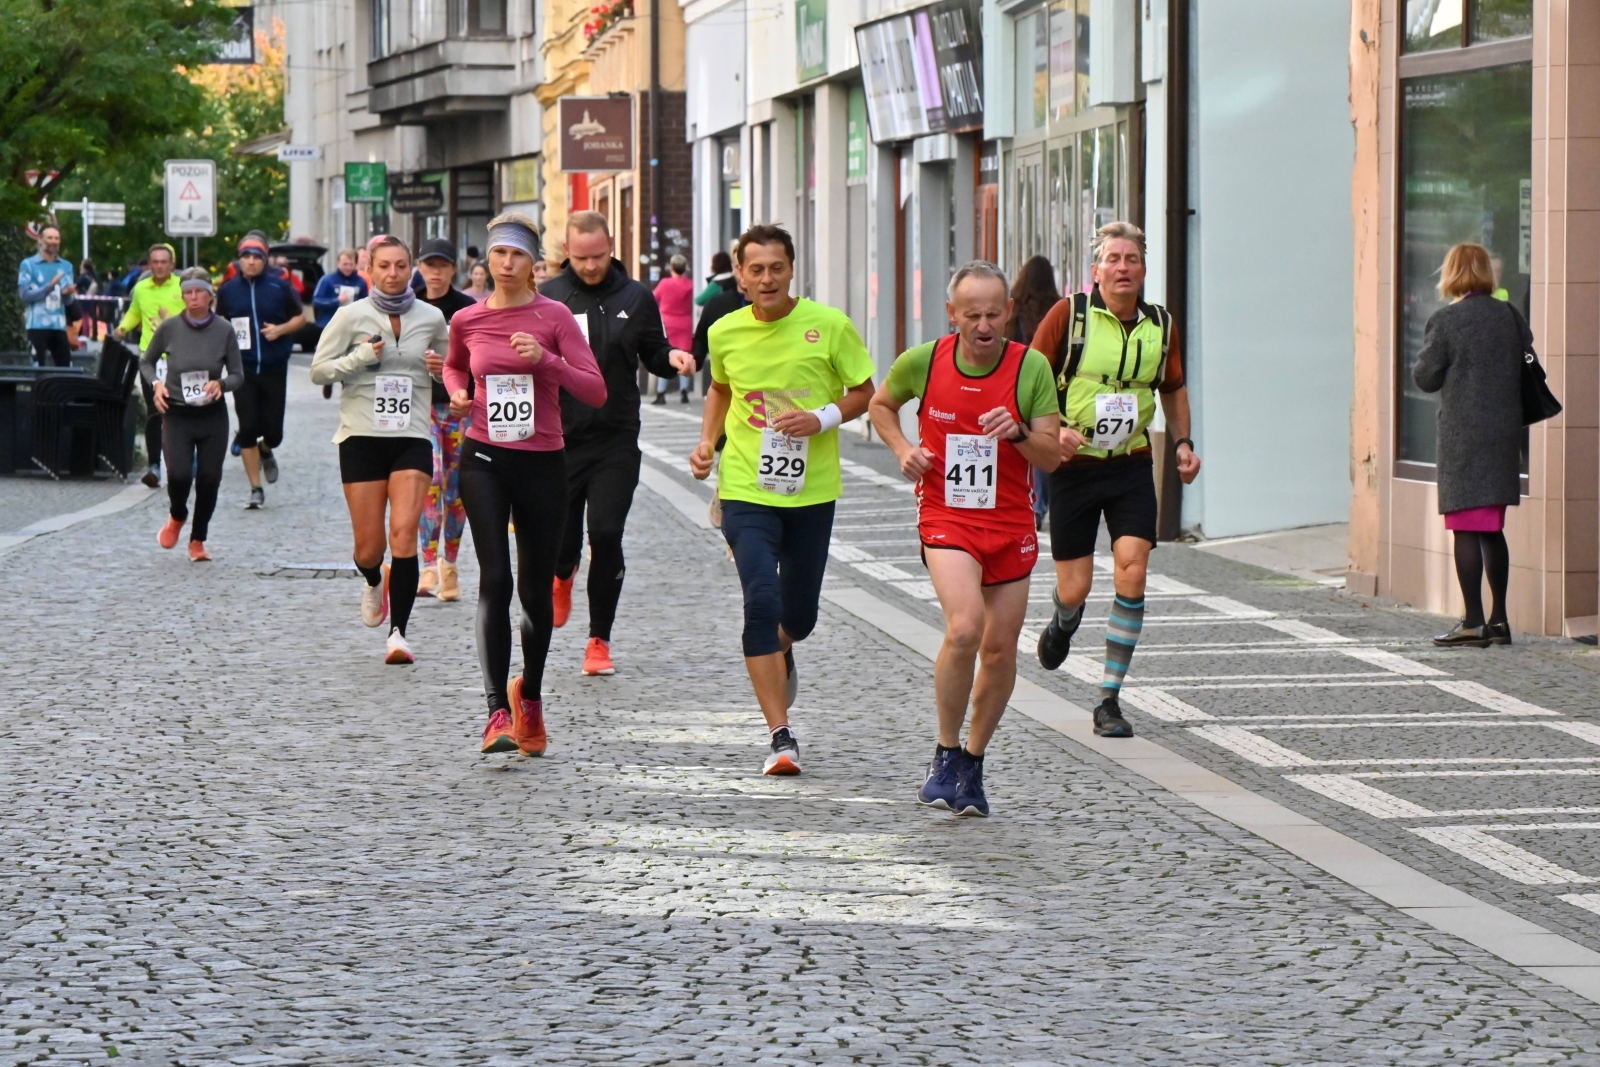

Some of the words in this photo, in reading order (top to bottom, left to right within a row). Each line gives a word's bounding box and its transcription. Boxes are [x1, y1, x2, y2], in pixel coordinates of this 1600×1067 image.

[171, 166, 209, 177] POZOR
[375, 397, 410, 414] 336
[488, 401, 532, 422] 209
[1096, 418, 1134, 435] 671
[759, 455, 805, 478] 329
[946, 464, 993, 487] 411
